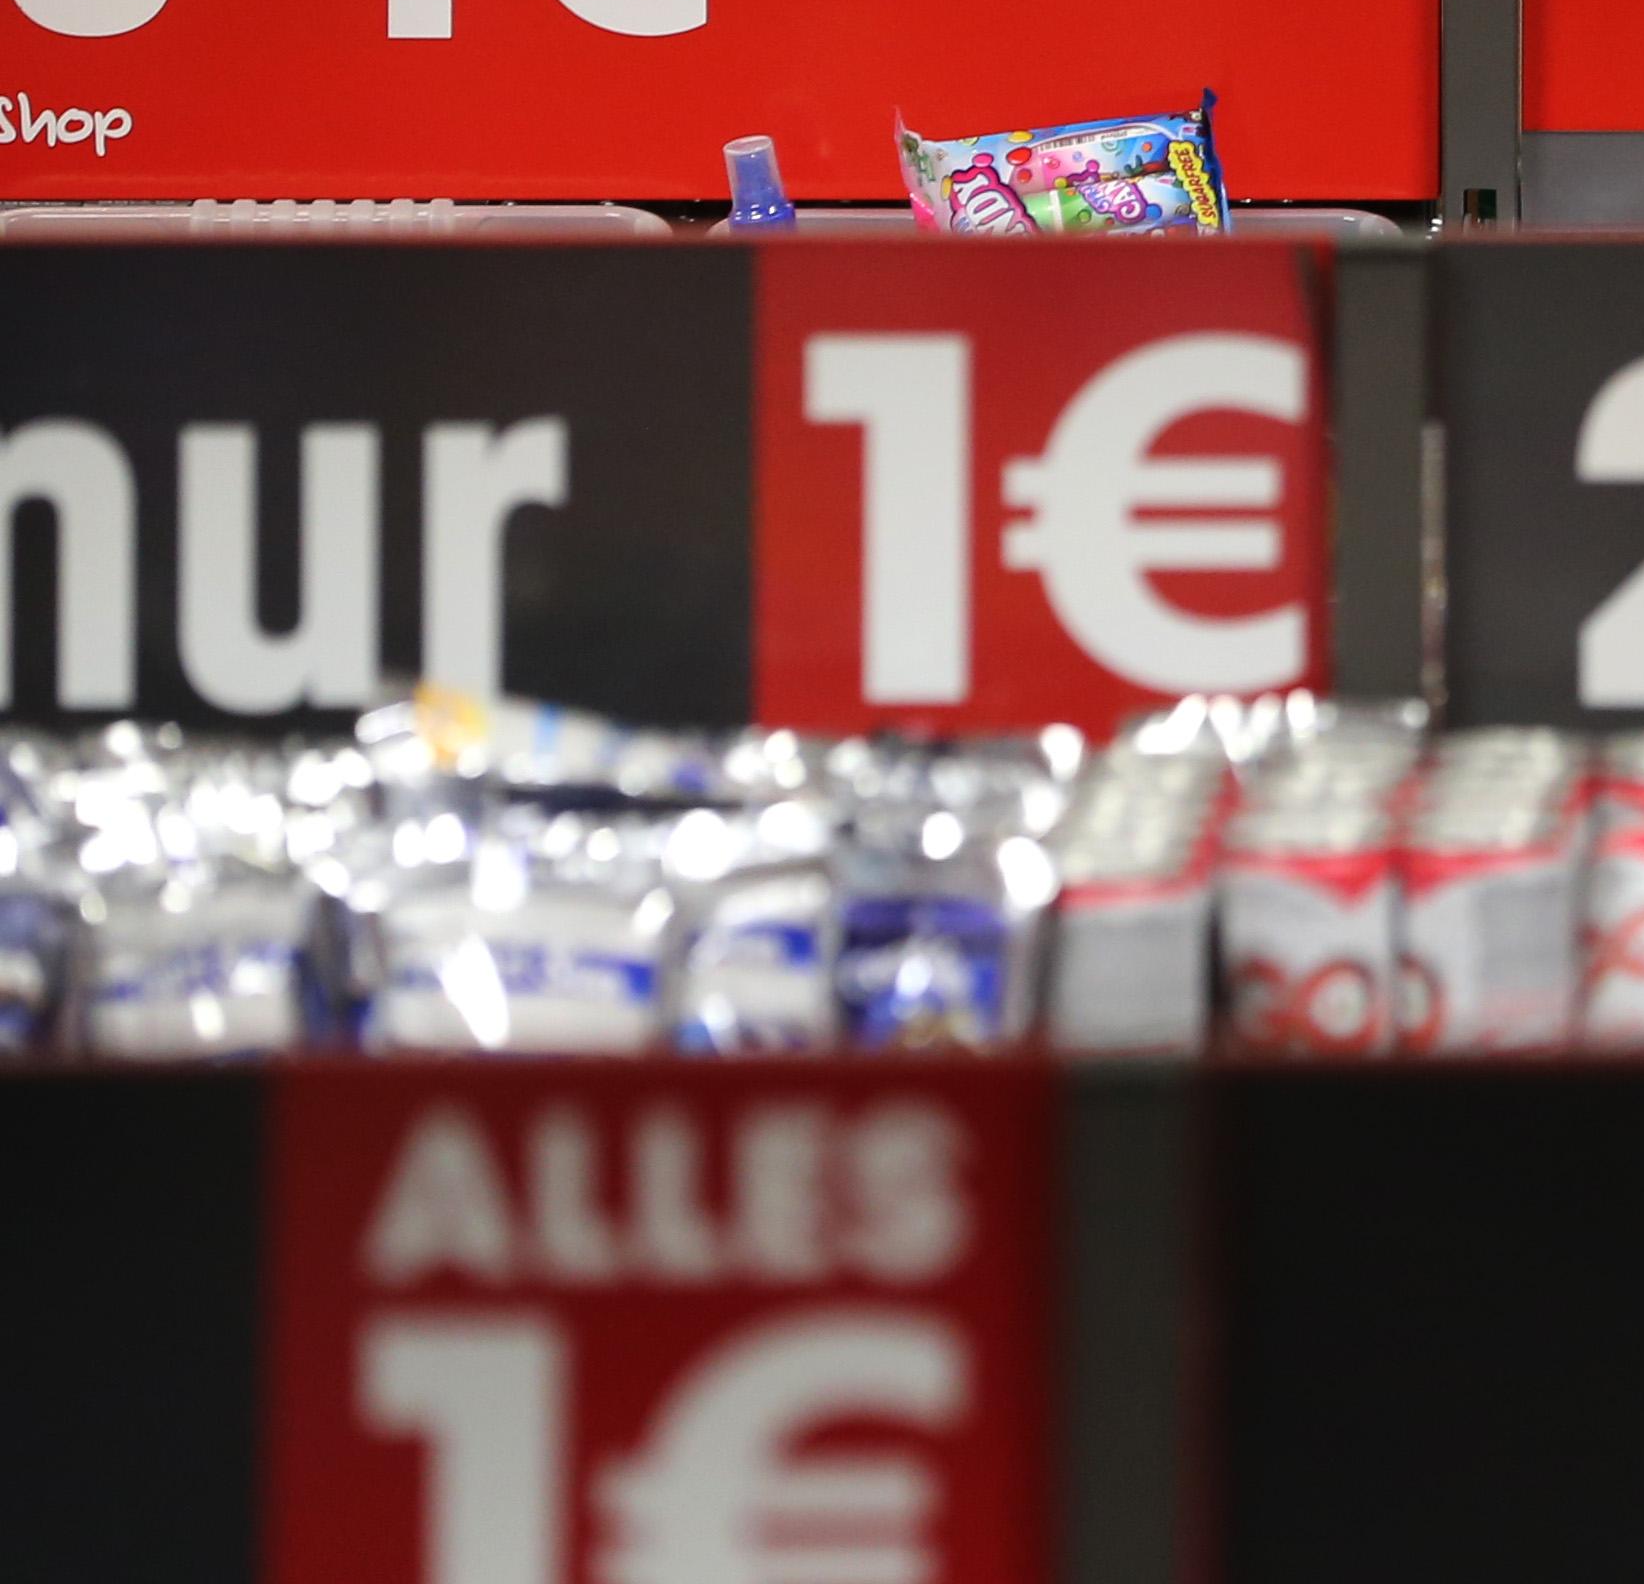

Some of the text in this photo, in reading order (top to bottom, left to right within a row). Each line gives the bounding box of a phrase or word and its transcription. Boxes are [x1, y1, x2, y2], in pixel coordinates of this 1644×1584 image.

[0, 333, 1308, 714] nur 1€
[368, 1104, 970, 1284] ALLES
[360, 1310, 966, 1584] 1€
